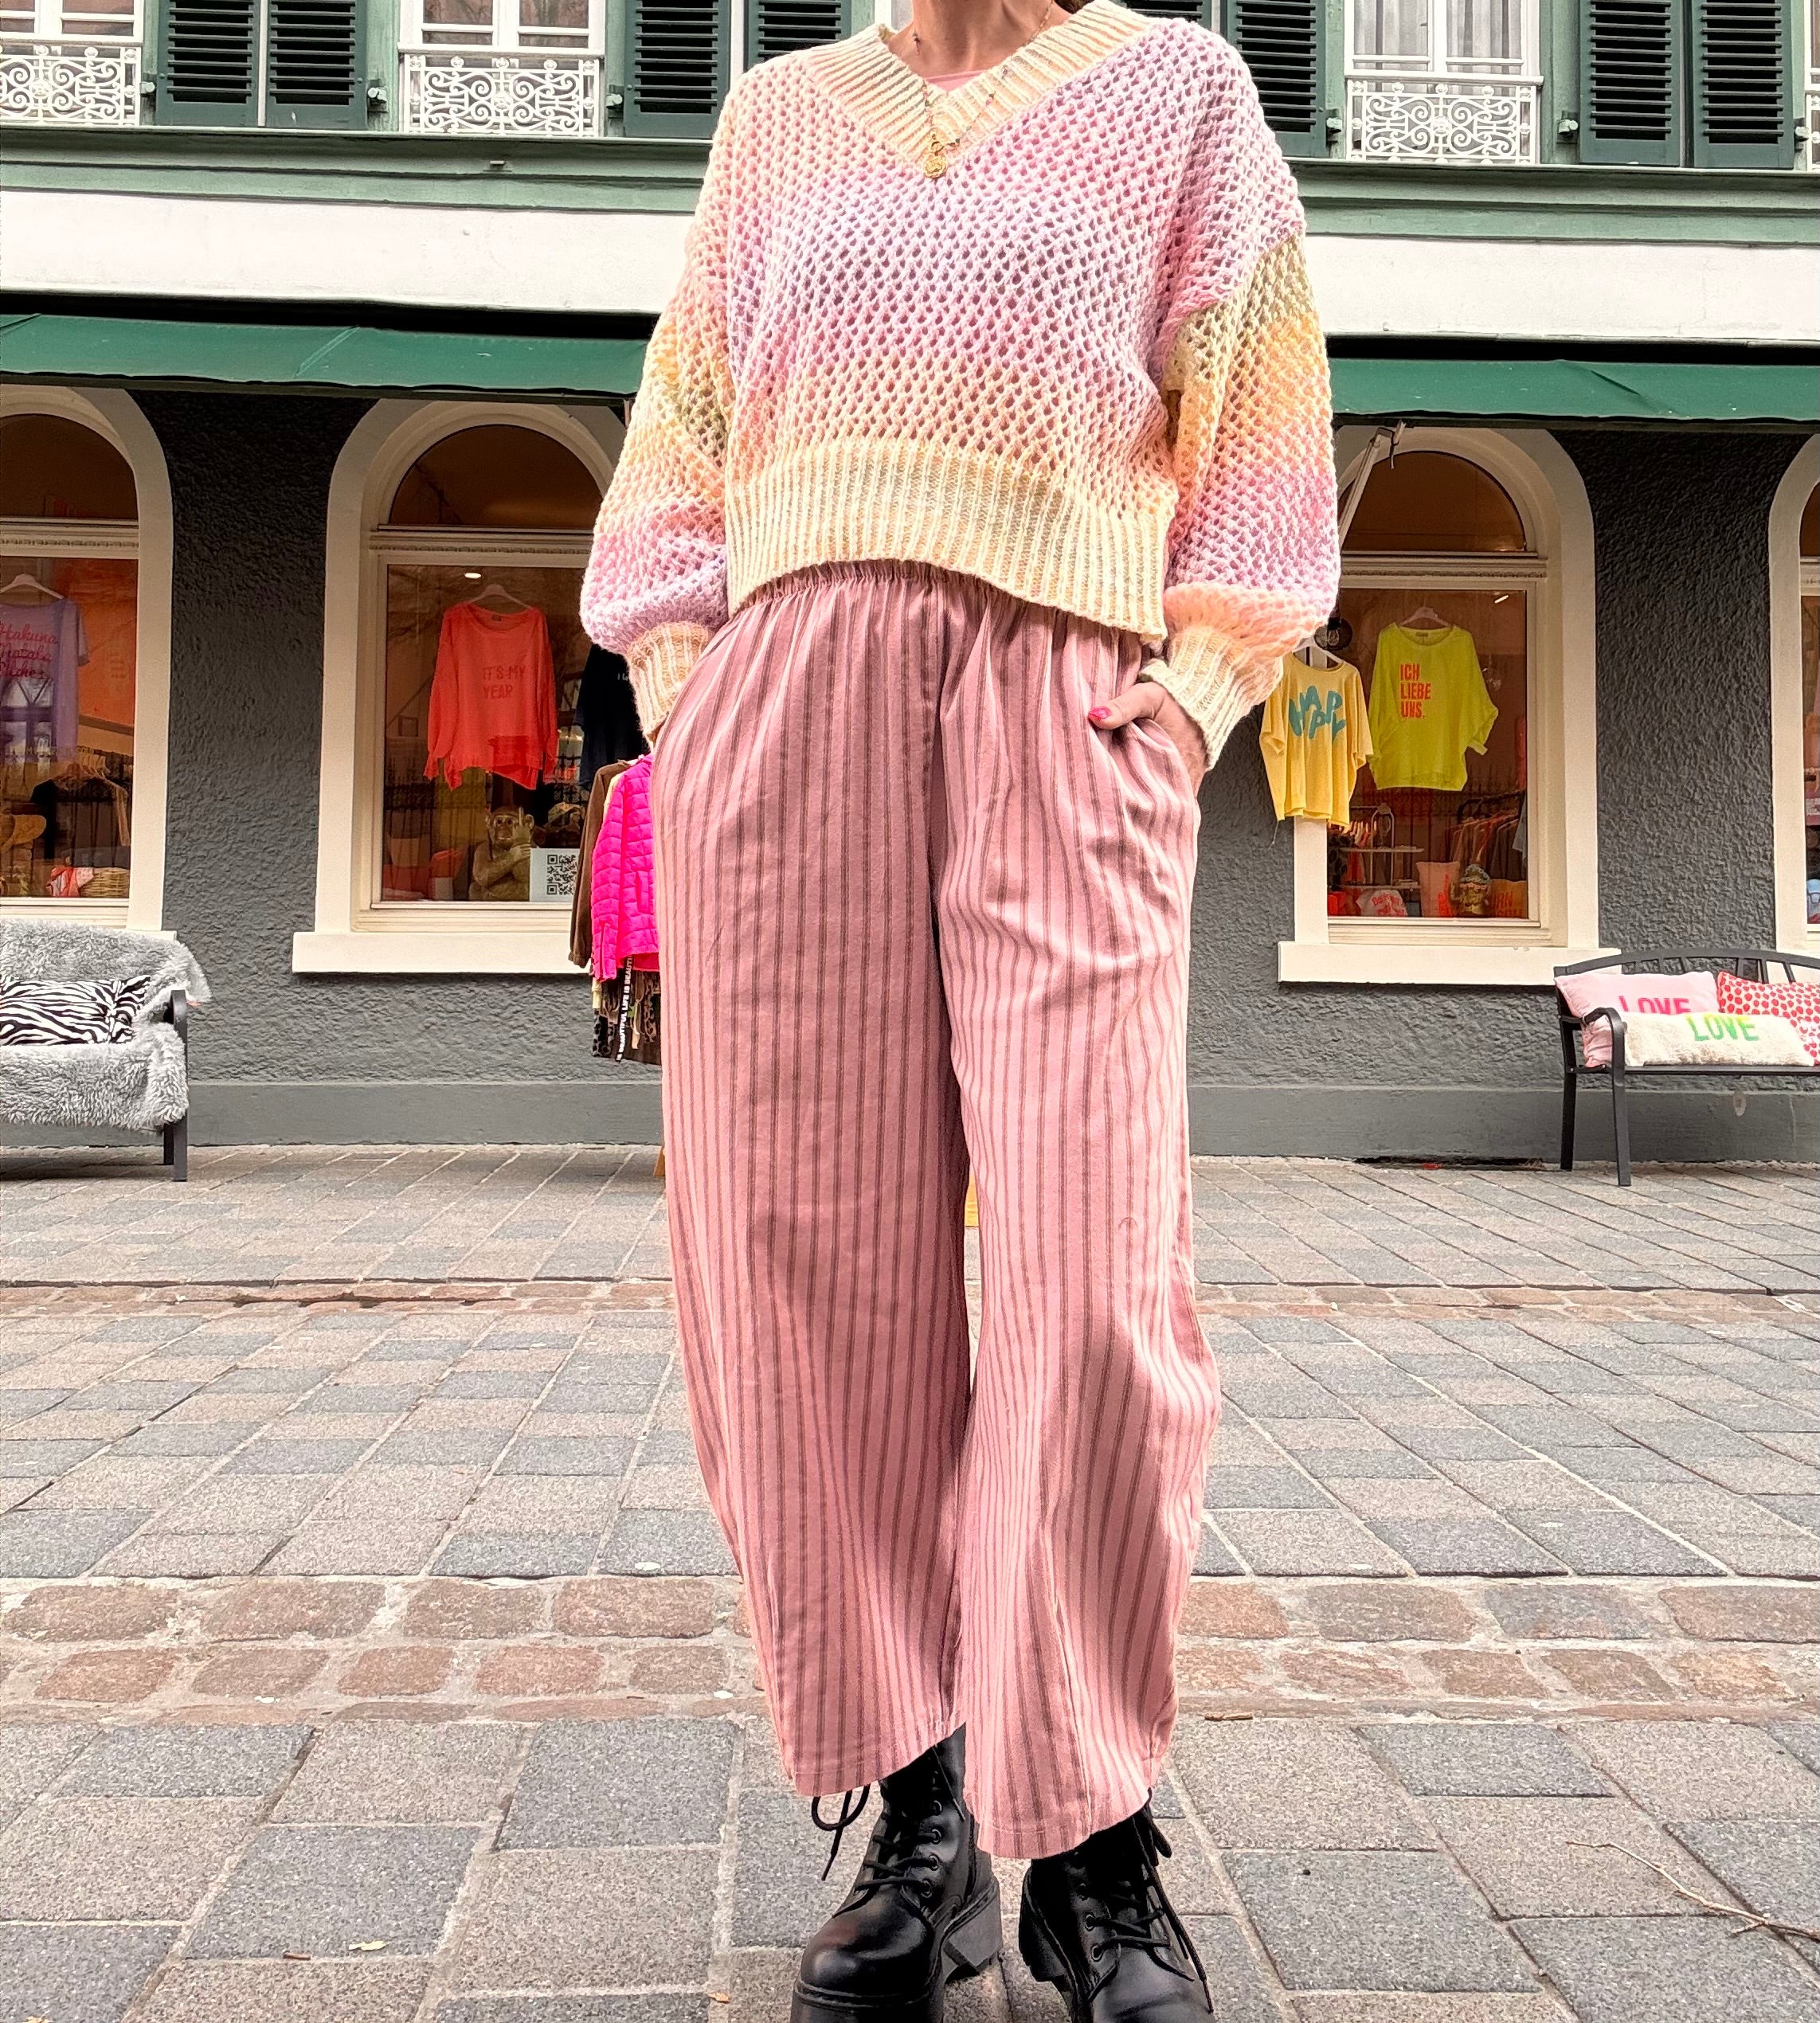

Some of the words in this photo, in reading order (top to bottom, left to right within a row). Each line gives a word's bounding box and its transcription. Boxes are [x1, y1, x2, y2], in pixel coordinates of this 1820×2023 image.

[508, 664, 526, 681] MY
[1400, 663, 1420, 681] ICH
[483, 685, 514, 699] YEAR
[1400, 682, 1432, 700] LIEBE
[1400, 701, 1427, 719] UNS.
[1685, 1013, 1759, 1042] LOVE
